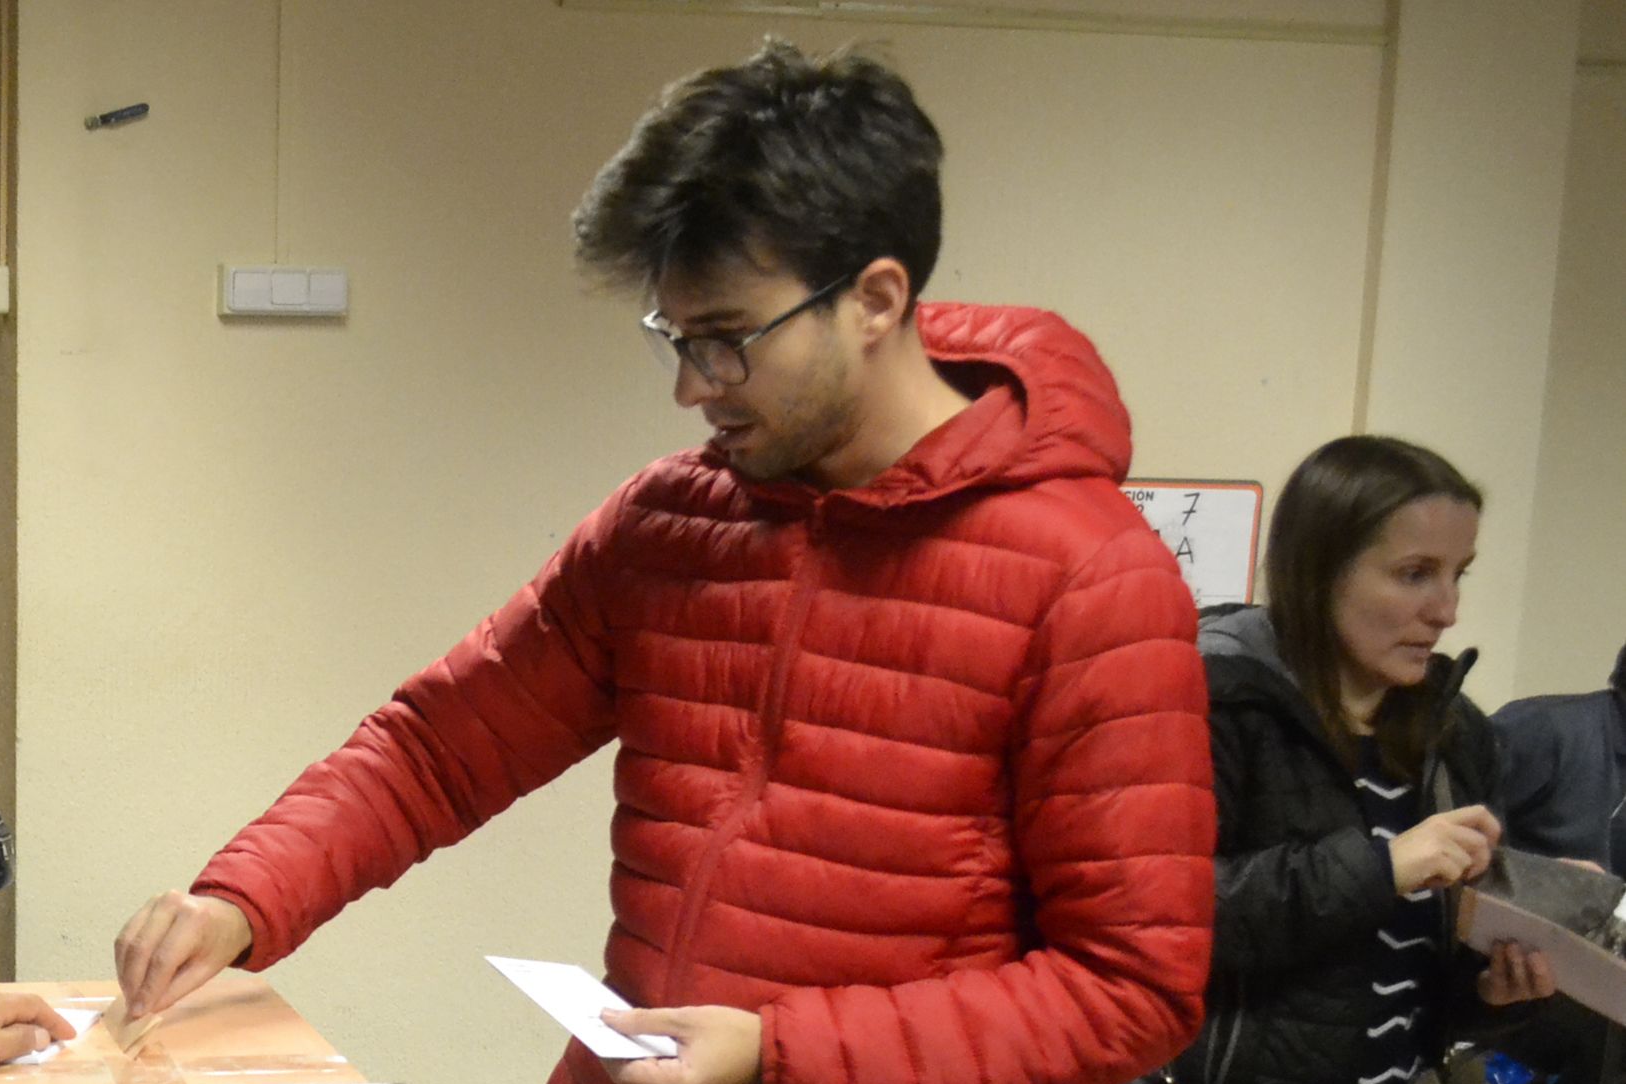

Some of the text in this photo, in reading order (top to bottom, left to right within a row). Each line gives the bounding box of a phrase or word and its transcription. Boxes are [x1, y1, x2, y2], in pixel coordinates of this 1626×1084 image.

[1124, 488, 1155, 502] CIÓN
[1182, 492, 1201, 526] 7
[1174, 536, 1195, 564] A
